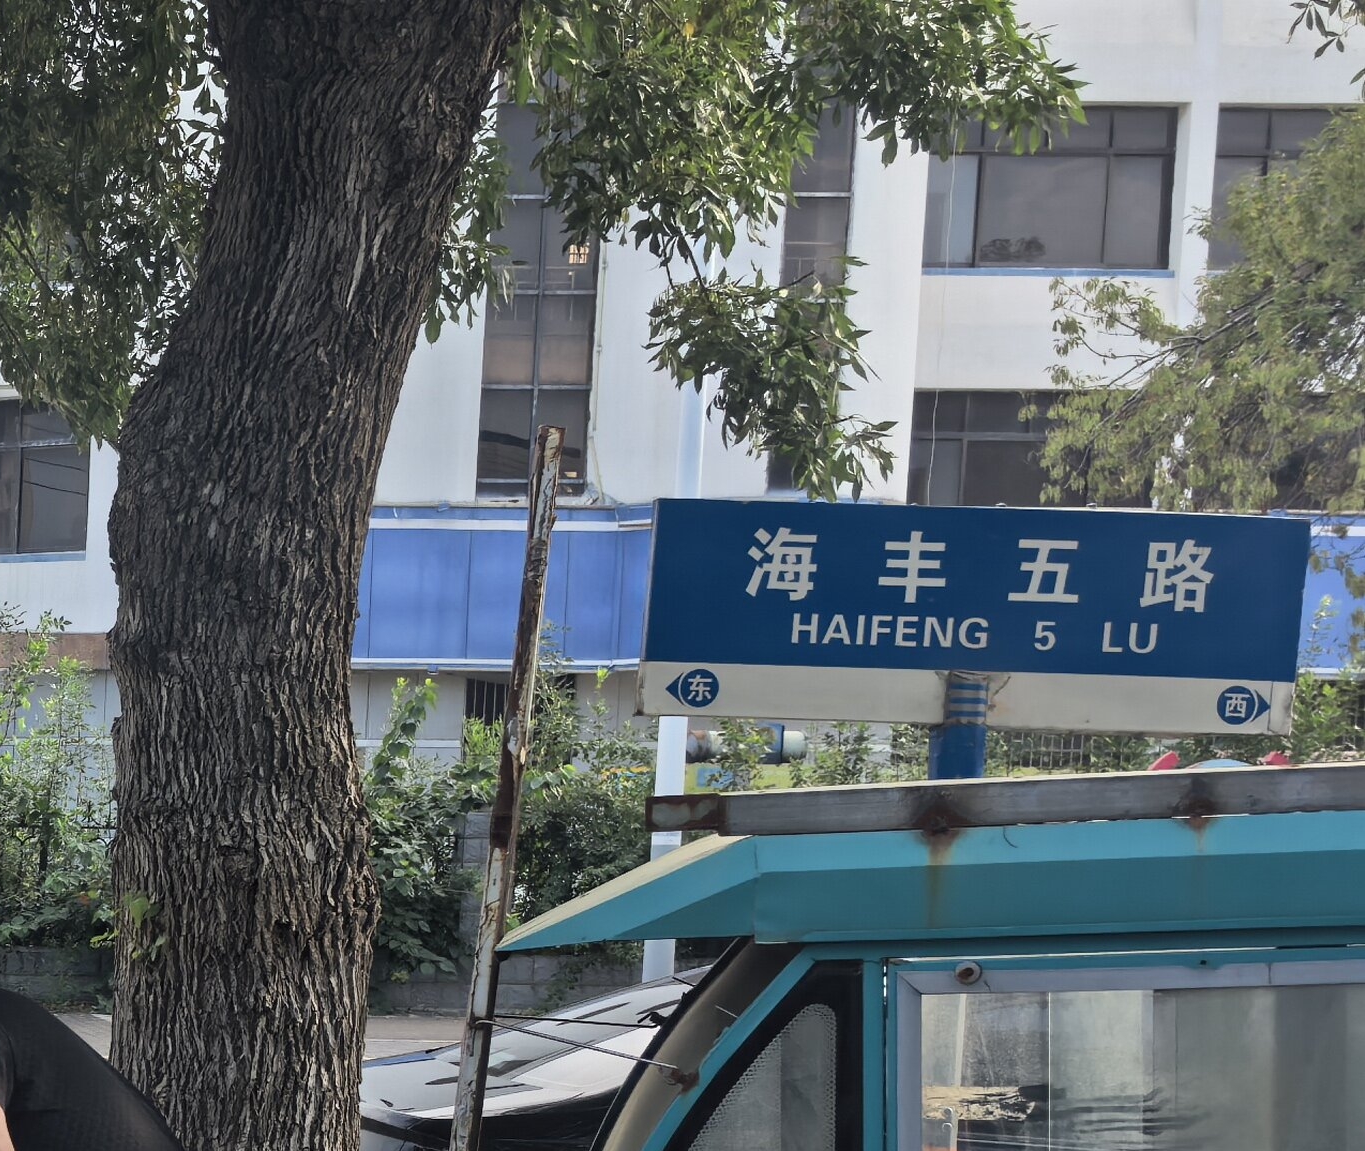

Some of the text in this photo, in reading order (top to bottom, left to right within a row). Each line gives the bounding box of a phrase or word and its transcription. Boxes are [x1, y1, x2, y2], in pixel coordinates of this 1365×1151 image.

[746, 527, 1214, 613] 海丰五路
[791, 613, 1159, 654] HAIFENG 5 LU
[687, 675, 713, 702] 东
[1225, 693, 1251, 718] 西
